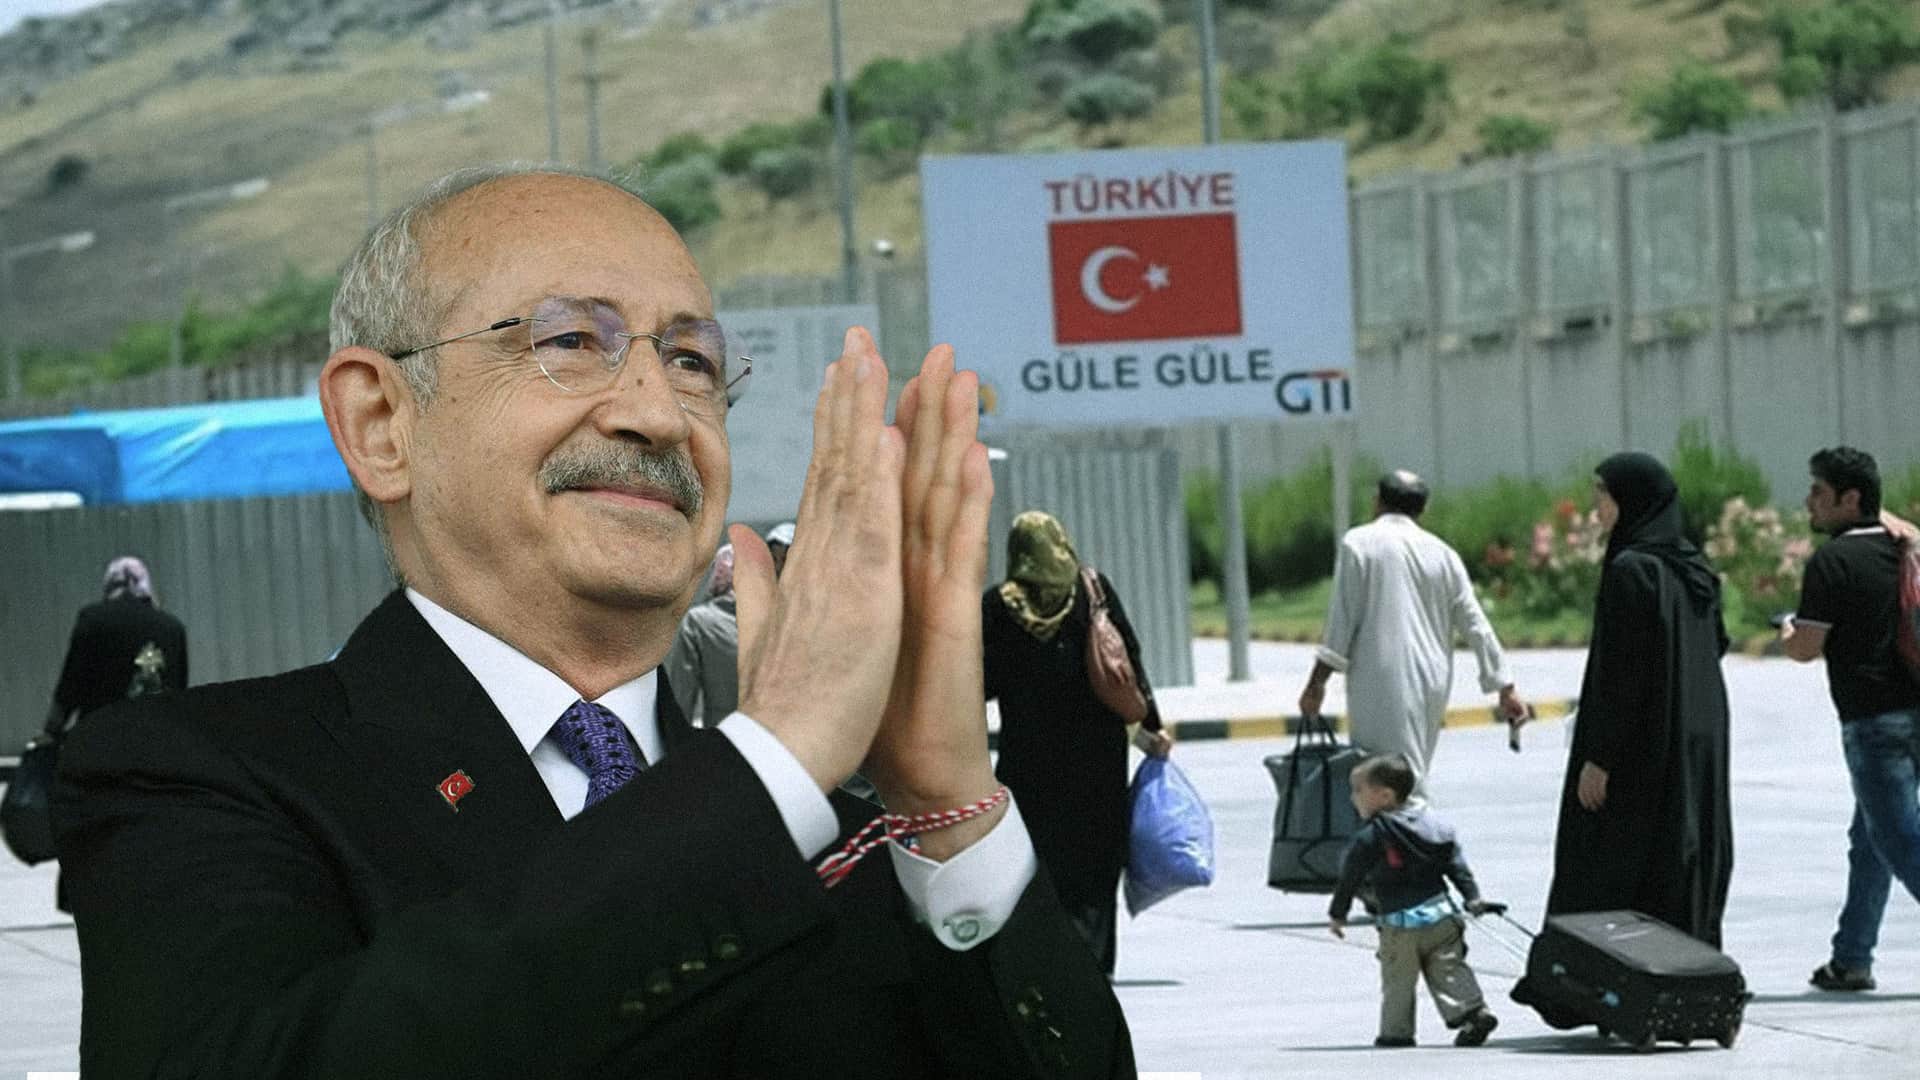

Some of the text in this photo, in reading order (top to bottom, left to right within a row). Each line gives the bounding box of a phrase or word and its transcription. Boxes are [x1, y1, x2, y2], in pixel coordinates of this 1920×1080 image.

[1045, 170, 1235, 214] TÜRKİYE
[1021, 345, 1274, 393] GÜLE GÜLE
